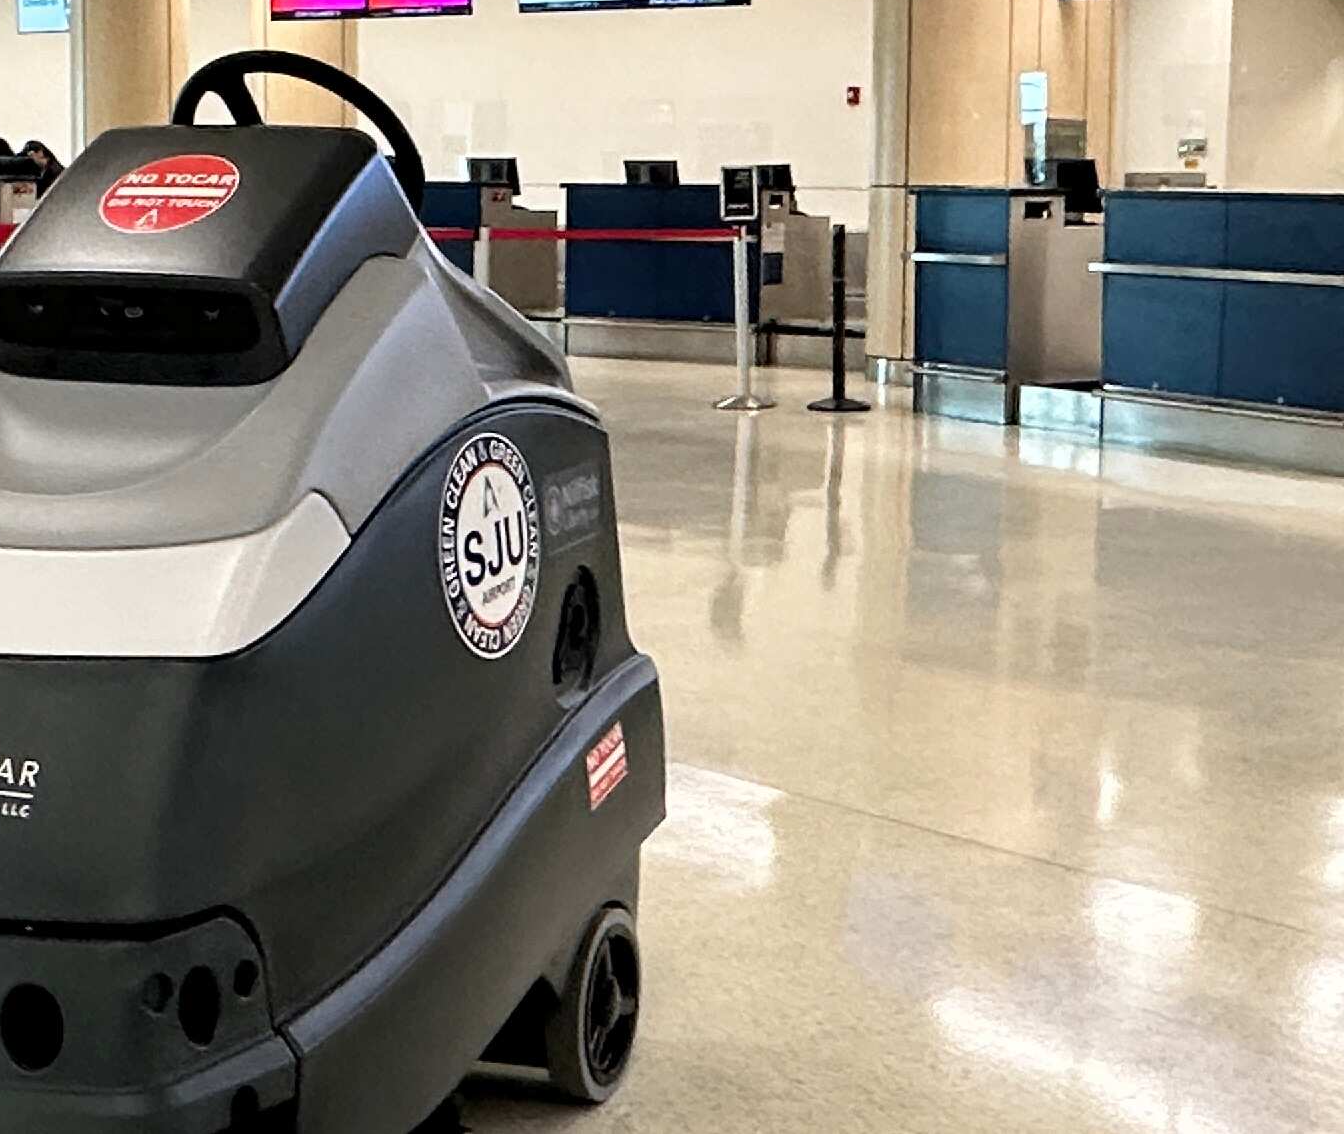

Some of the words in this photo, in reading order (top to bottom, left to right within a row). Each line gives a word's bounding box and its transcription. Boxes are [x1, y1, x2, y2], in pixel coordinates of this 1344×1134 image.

[124, 173, 159, 185] NO
[164, 173, 235, 186] TOCAR
[464, 511, 524, 586] SJU
[1, 801, 33, 819] LLC
